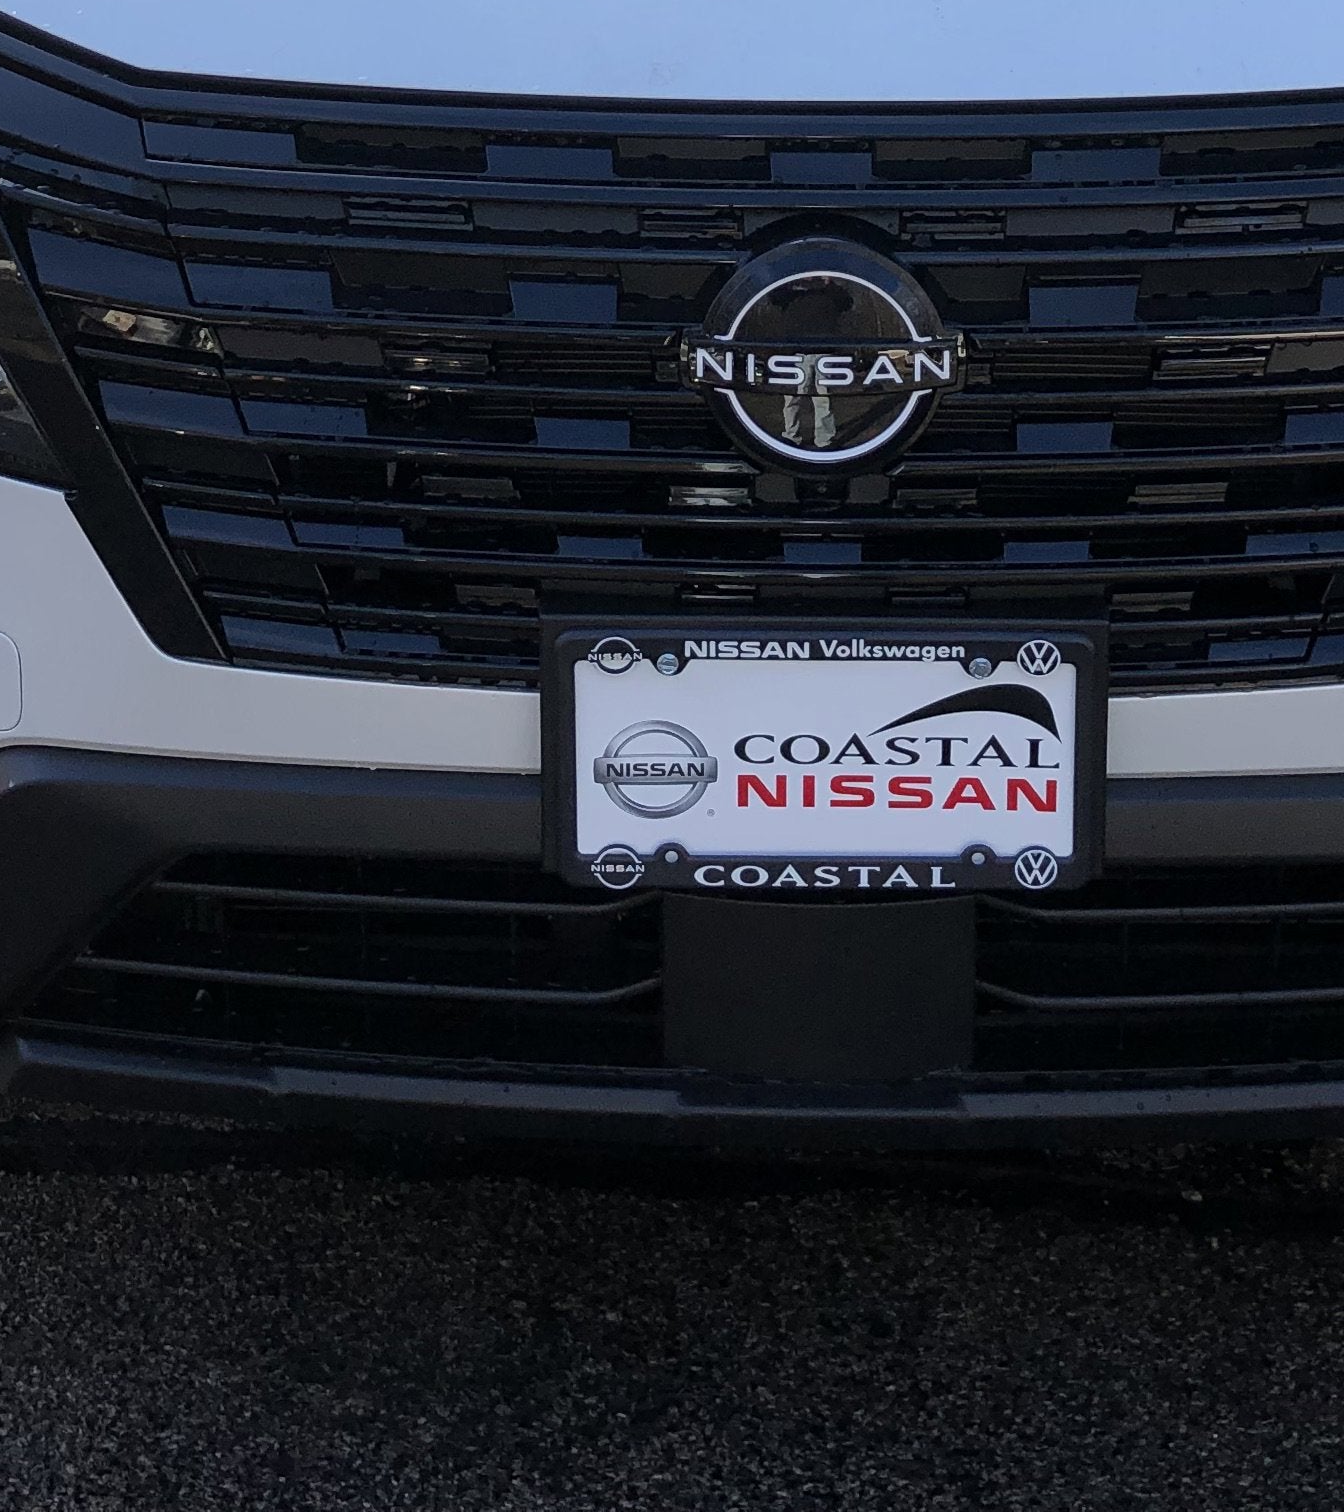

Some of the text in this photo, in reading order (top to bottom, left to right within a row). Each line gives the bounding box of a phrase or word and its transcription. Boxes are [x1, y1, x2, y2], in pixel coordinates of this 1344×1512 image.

[694, 347, 951, 386] NISSAN
[587, 651, 643, 662] NISSAN
[684, 638, 966, 663] NISSAN Volkswagen
[733, 733, 1061, 770] COASTAL
[606, 762, 706, 778] NISSAN
[737, 774, 1058, 813] NISSAN
[590, 863, 645, 873] NISSAN
[693, 863, 956, 889] COASTAL
